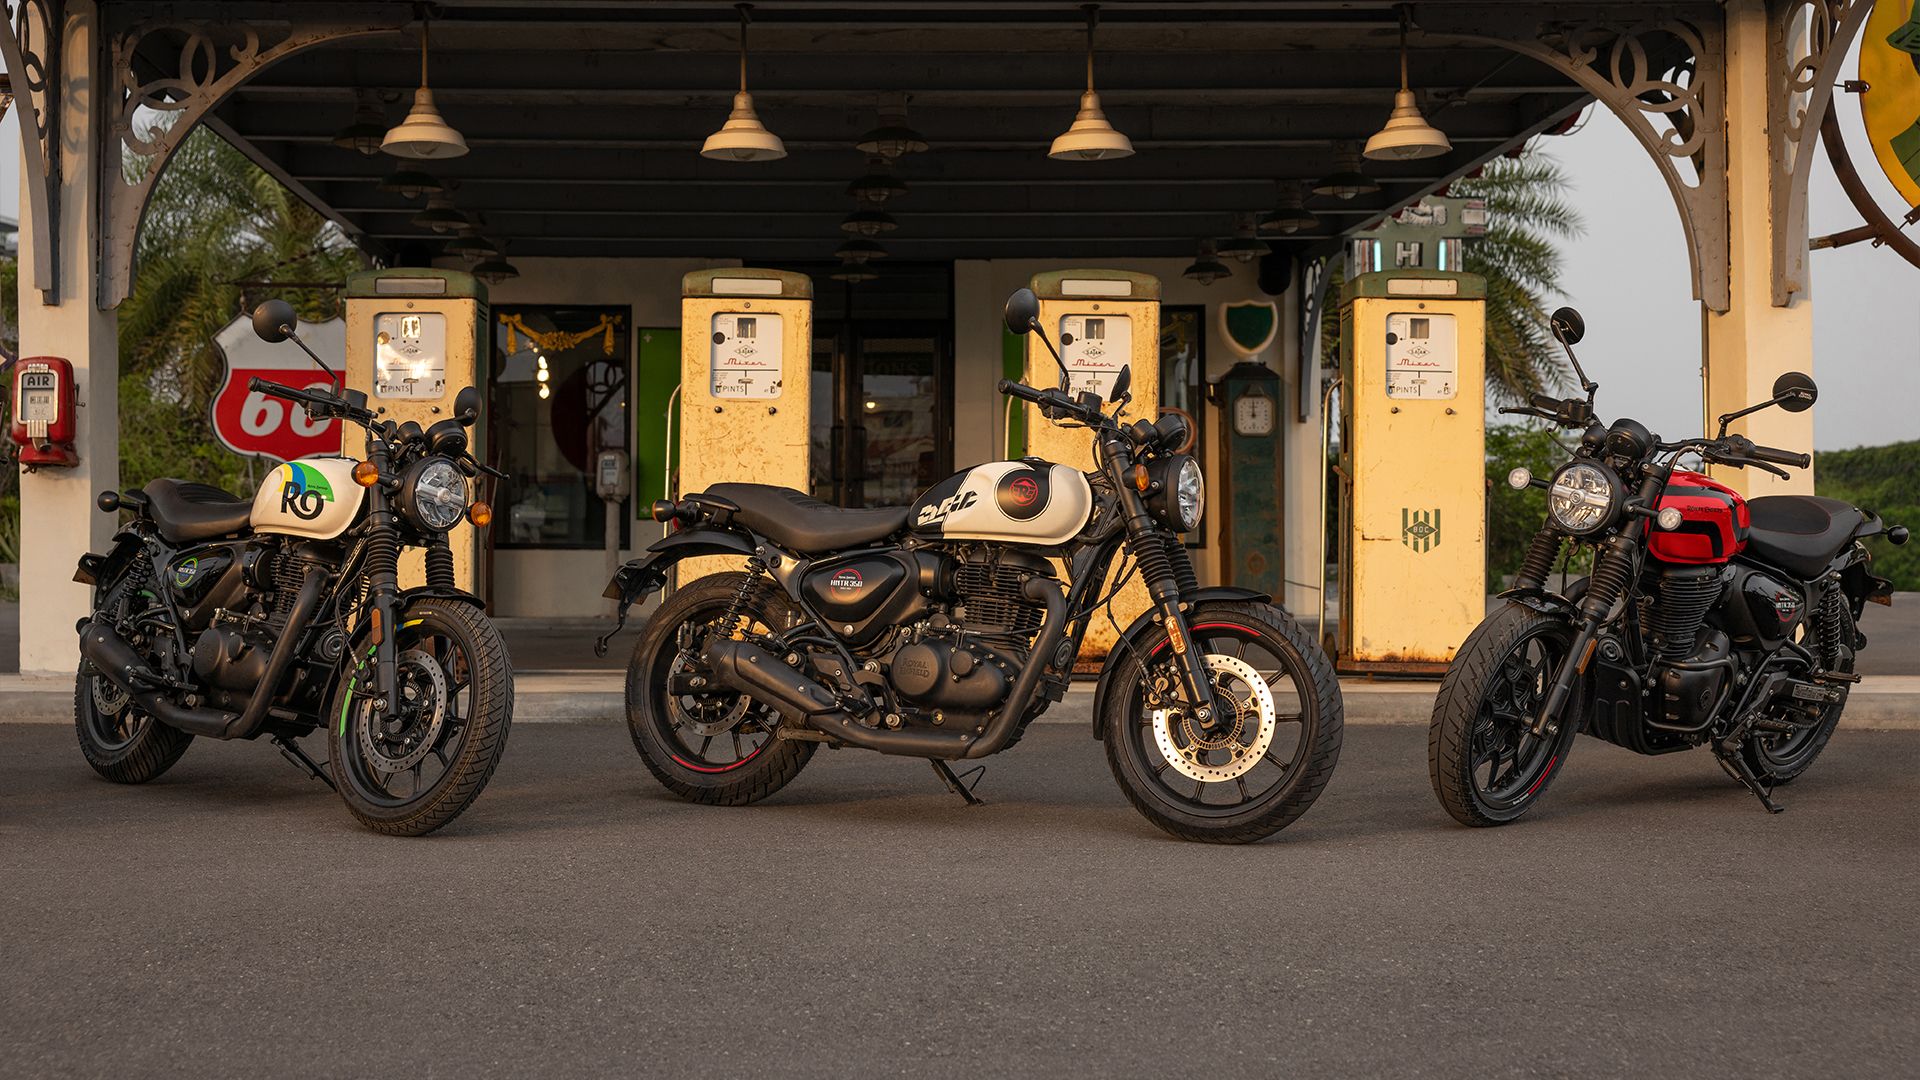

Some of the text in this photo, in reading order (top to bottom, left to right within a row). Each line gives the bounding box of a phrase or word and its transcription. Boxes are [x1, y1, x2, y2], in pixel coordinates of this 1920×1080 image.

[724, 358, 767, 366] Mixer
[1072, 359, 1115, 367] Mixer
[1397, 358, 1440, 366] Mixer
[27, 376, 50, 386] AIR
